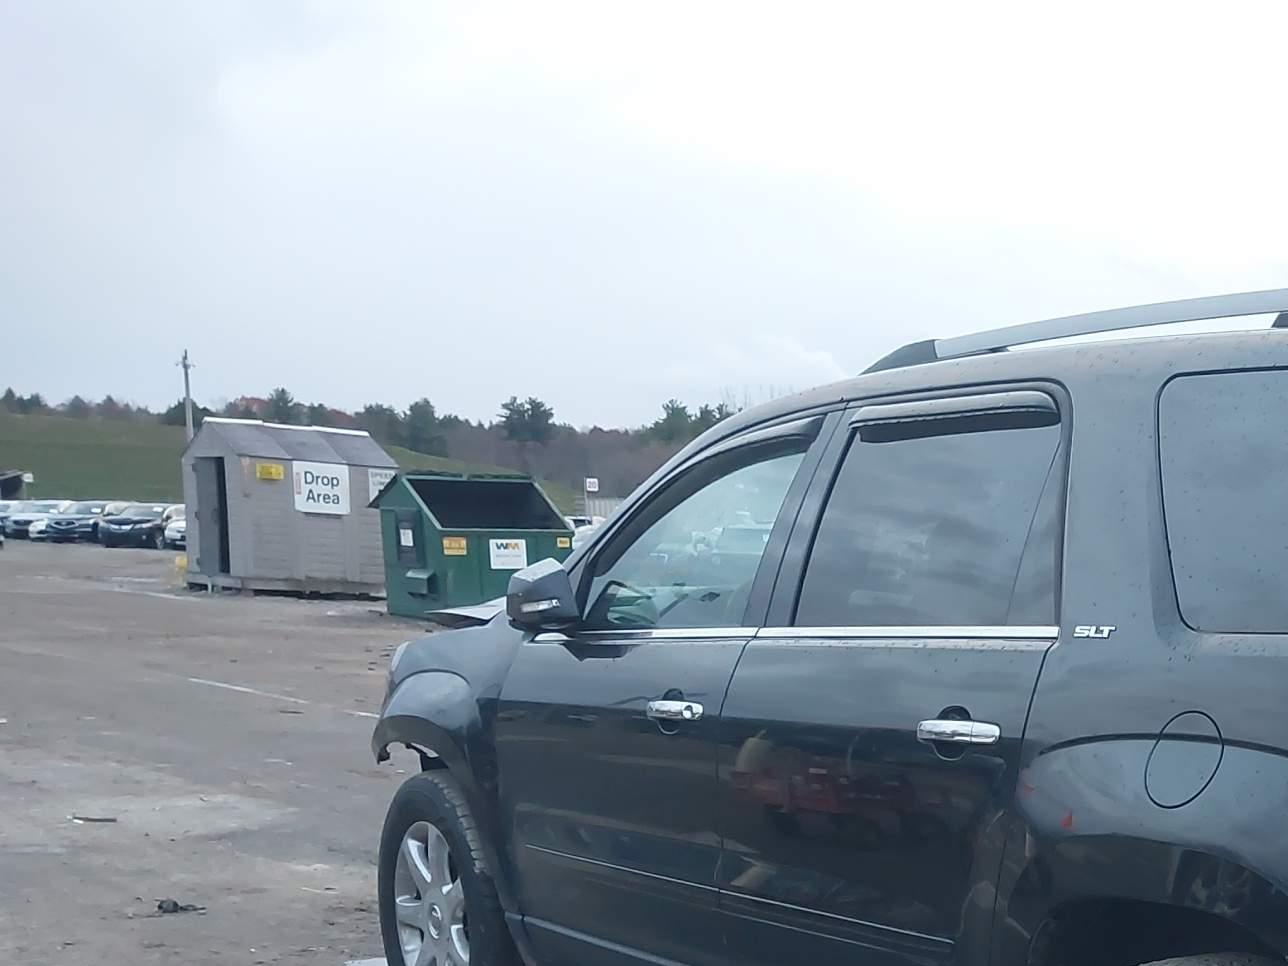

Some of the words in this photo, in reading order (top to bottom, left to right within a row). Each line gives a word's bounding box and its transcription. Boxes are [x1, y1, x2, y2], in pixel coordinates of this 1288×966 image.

[304, 471, 341, 489] Drop
[306, 489, 341, 505] Area
[495, 542, 520, 550] WM
[1073, 625, 1116, 639] SLT
